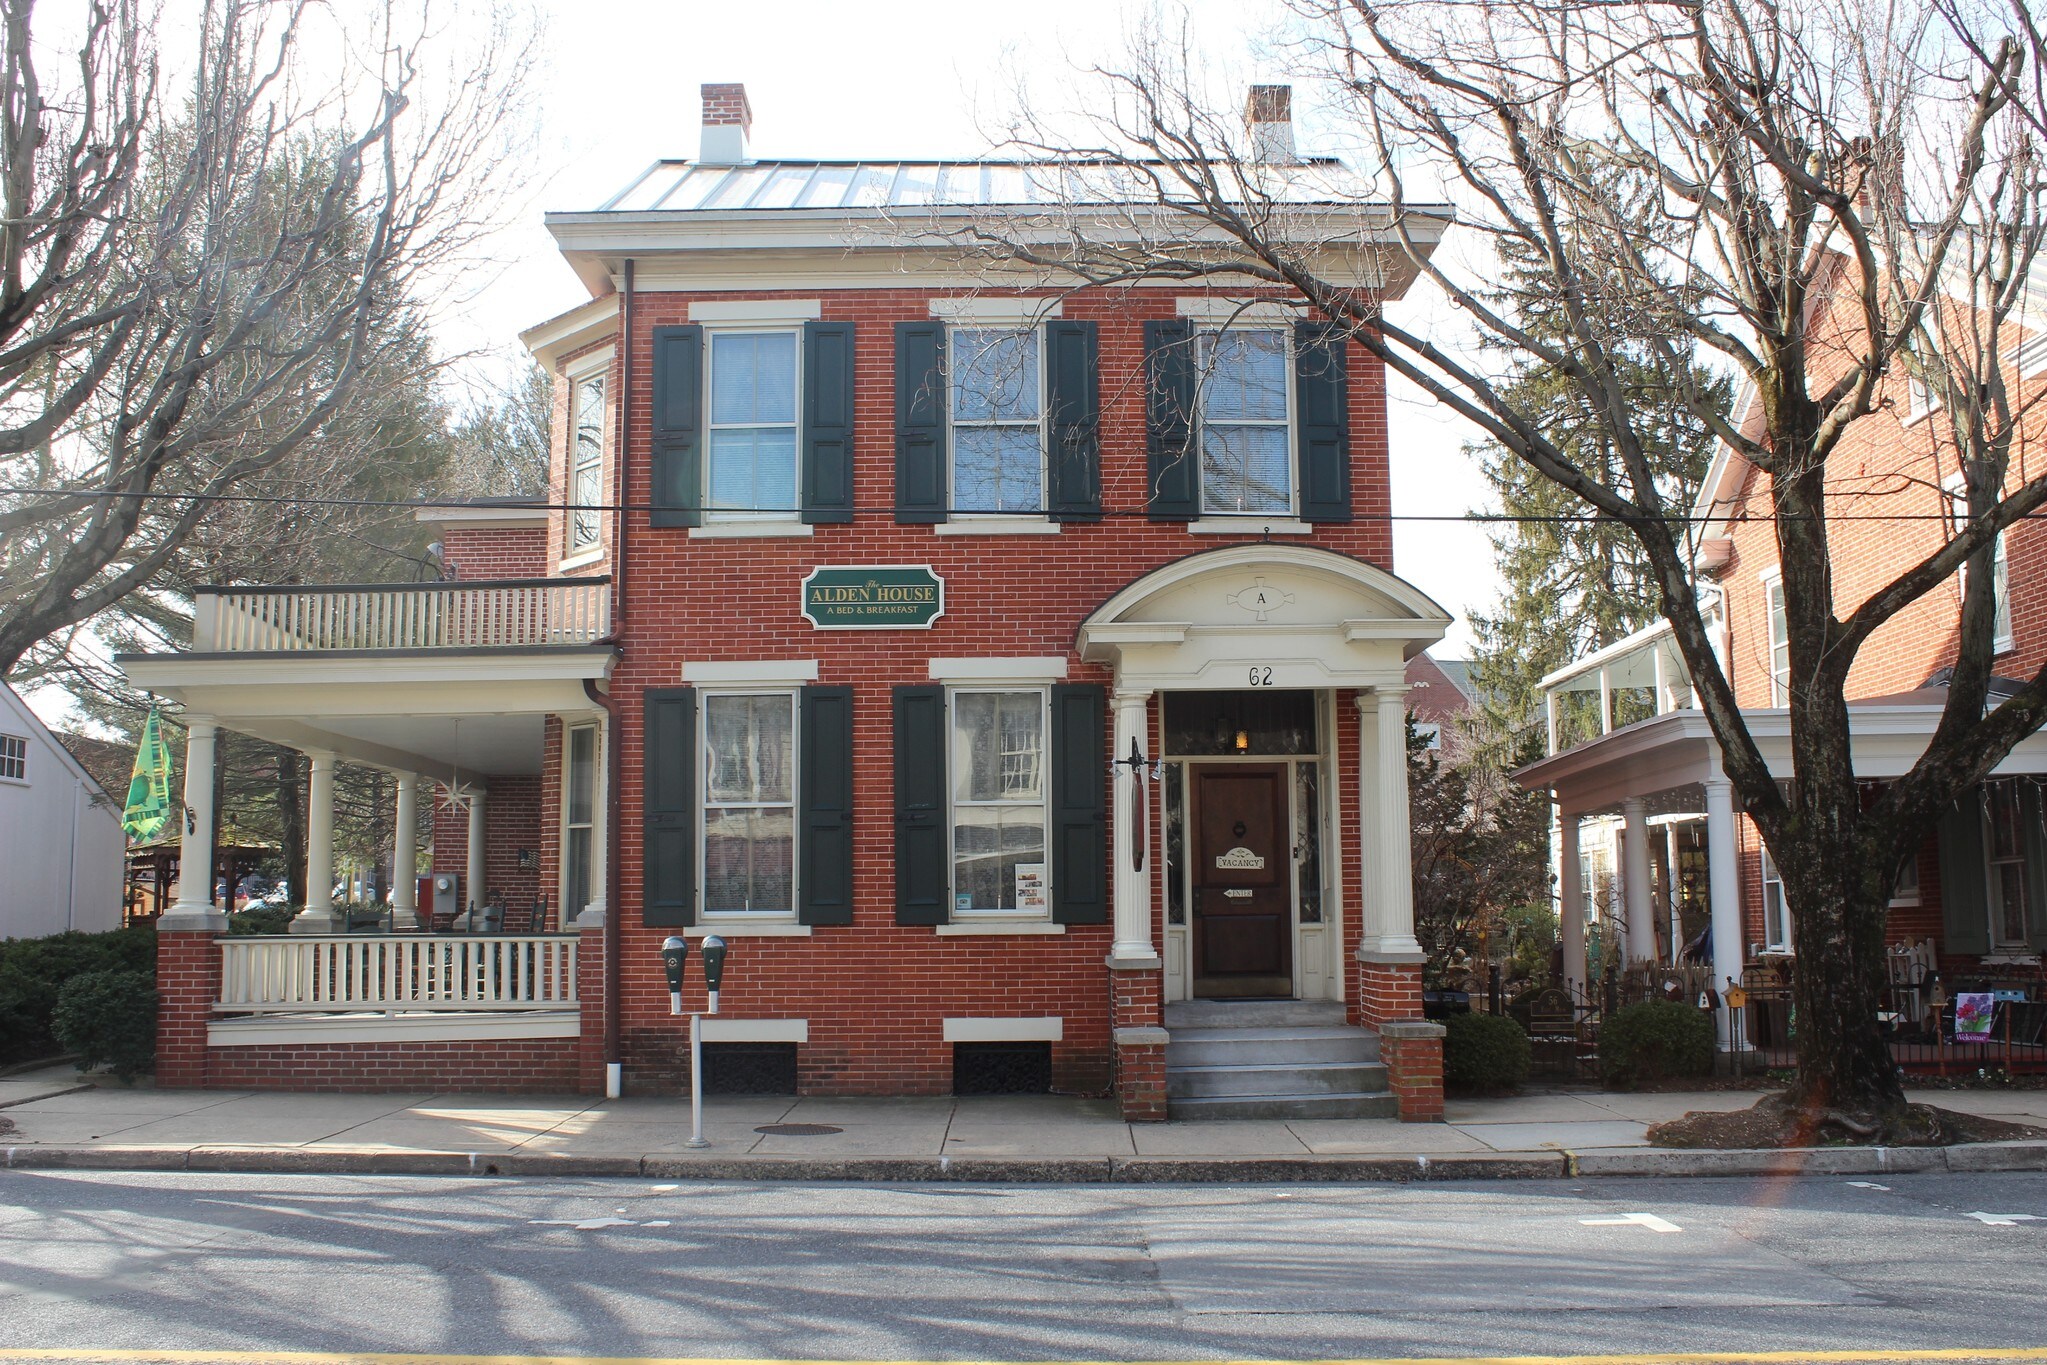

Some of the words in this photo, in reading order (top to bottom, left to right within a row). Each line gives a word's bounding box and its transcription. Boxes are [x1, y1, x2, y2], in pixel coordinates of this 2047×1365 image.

[865, 579, 880, 588] The
[811, 588, 870, 602] ALDEN
[877, 587, 934, 601] HOUSE
[1257, 593, 1266, 603] A
[826, 606, 834, 614] A
[836, 606, 855, 614] BED
[866, 605, 918, 613] BREAKFAST
[1249, 666, 1273, 686] 62
[1221, 859, 1260, 867] VACANCY
[1956, 1033, 1987, 1041] Welcome
